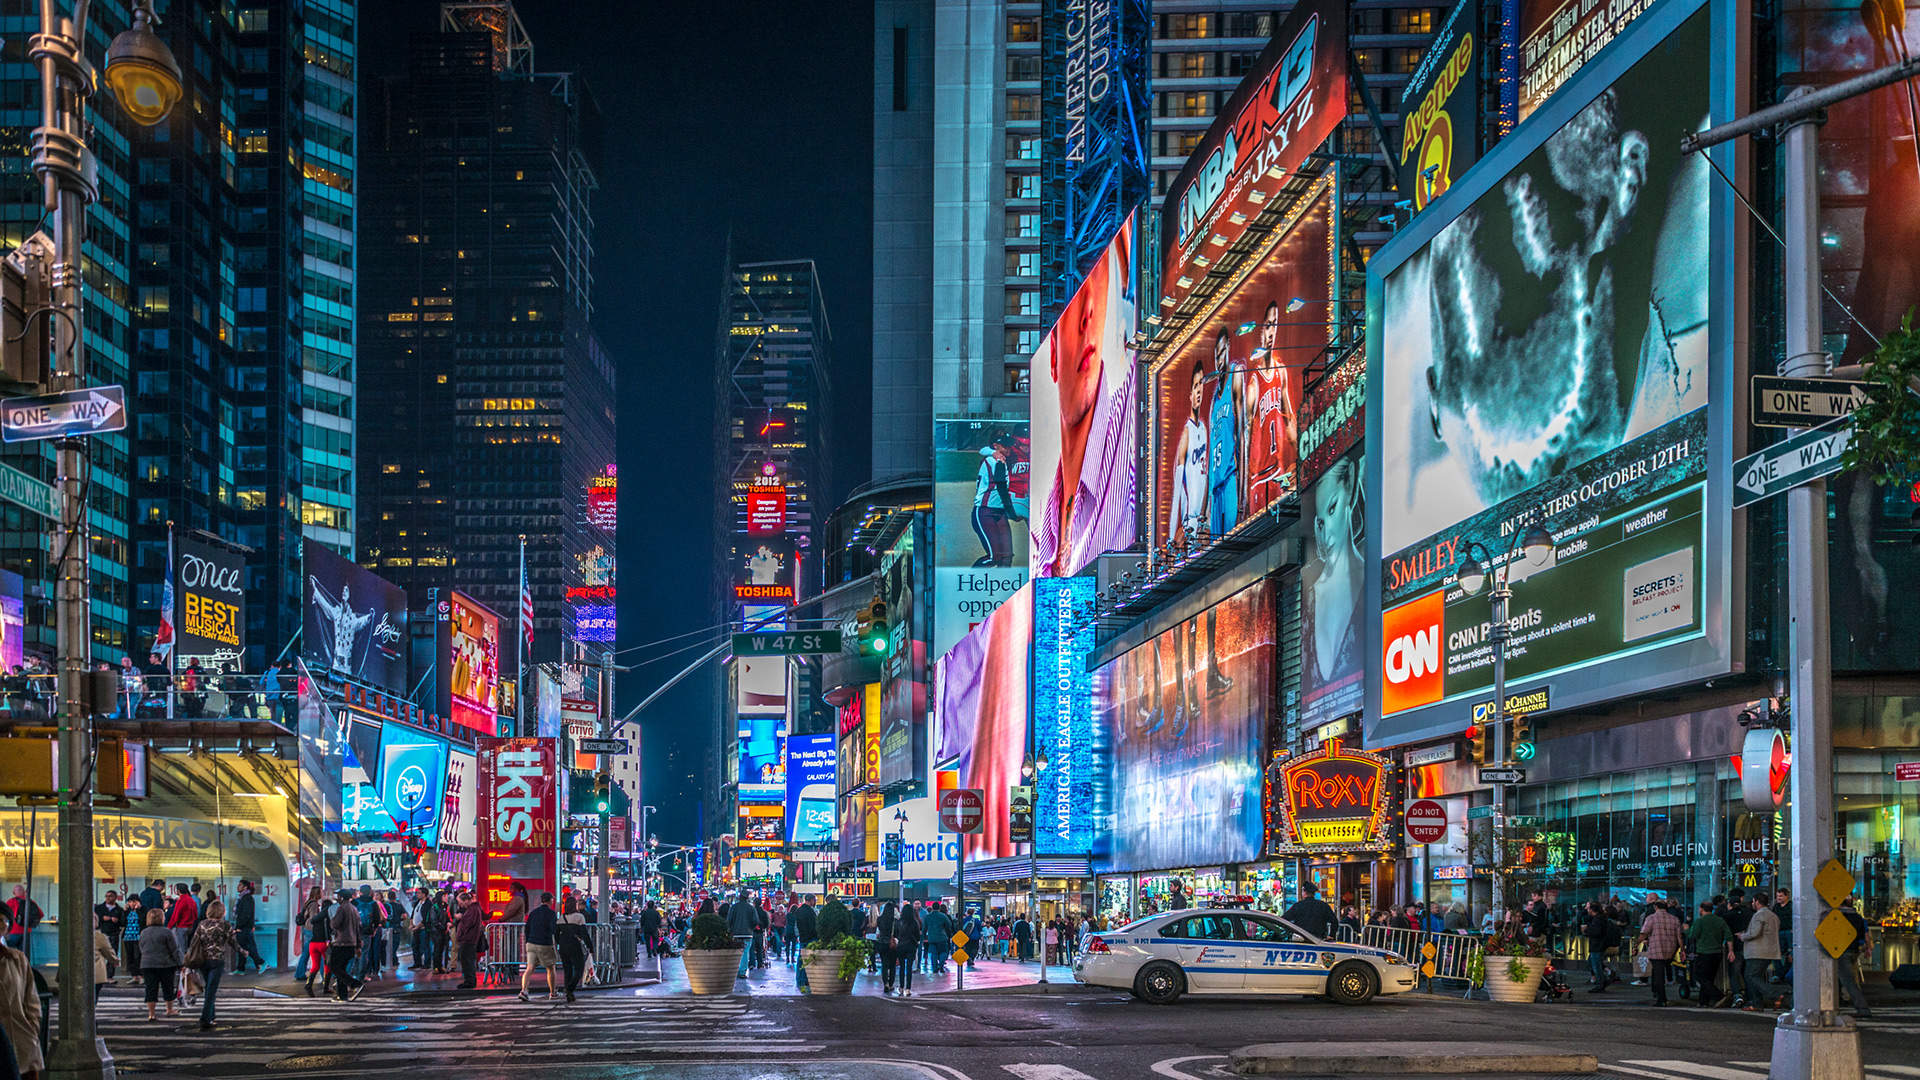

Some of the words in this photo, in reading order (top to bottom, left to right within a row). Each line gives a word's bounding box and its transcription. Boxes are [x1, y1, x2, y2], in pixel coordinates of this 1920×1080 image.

[1402, 33, 1472, 163] Avenue
[1179, 222, 1209, 268] EXECUTIVE
[1209, 178, 1243, 229] PRODUCED
[1243, 165, 1253, 185] BY
[1252, 113, 1294, 183] JAY
[1297, 89, 1314, 132] Z
[13, 406, 51, 426] ONE
[72, 401, 109, 420] WAY
[1773, 392, 1811, 412] ONE
[1829, 396, 1867, 414] WAY
[1299, 374, 1366, 460] CHICAGO
[1012, 461, 1030, 475] WEST
[1747, 460, 1778, 488] ONE
[1800, 437, 1836, 467] WAY
[748, 485, 785, 493] TOSHIBA
[755, 477, 780, 486] 2012
[1500, 519, 1514, 538] IN
[1580, 467, 1648, 503] OCTOBER
[1651, 439, 1689, 472] 12TH
[1625, 508, 1668, 534] weather
[1564, 527, 1578, 539] may
[1557, 539, 1588, 560] mobile
[1390, 536, 1459, 590] SMILEY
[735, 586, 793, 597] TOSHIBA
[957, 574, 1022, 596] Helped
[1632, 575, 1676, 597] SECRETS
[1632, 593, 1656, 606] BELFAST
[1657, 585, 1684, 598] PROJECT
[1445, 589, 1464, 603] .com
[185, 592, 239, 625] BEST
[185, 614, 239, 639] MUSICAL
[185, 625, 200, 636] 2012
[201, 630, 217, 640] TONY
[217, 633, 239, 646] AWARD
[1448, 626, 1478, 651] CNN
[1481, 608, 1542, 641] Pents
[752, 637, 766, 650] W
[772, 636, 796, 649] 47
[803, 635, 821, 649] St
[1058, 588, 1072, 691] OUTFITTERS
[1448, 653, 1461, 665] CNN
[1461, 645, 1493, 662] investigates
[1527, 629, 1545, 641] about
[1551, 622, 1572, 634] violent
[1573, 616, 1587, 628] time
[1588, 612, 1595, 623] in
[1386, 625, 1439, 684] CNN
[1448, 662, 1471, 675] Northern
[561, 718, 593, 727] EXPERIENCE
[840, 691, 861, 737] Kodak
[1057, 694, 1071, 749] EAGLE
[496, 747, 543, 842] tkts
[947, 798, 958, 806] DO
[961, 798, 976, 806] NOT
[1057, 752, 1071, 841] AMERICAN
[806, 809, 831, 823] 12:45
[949, 817, 974, 825] ENTER
[1412, 808, 1423, 816] DO
[1425, 808, 1440, 816] NOT
[1468, 806, 1490, 819] BROADWAY
[1526, 817, 1537, 826] 47
[1303, 825, 1363, 838] DELICATESSEN
[1414, 828, 1439, 836] ENTER
[1580, 848, 1608, 862] BLUE
[1612, 847, 1630, 859] FIN
[1651, 843, 1683, 858] BLUE
[1687, 842, 1708, 855] FIN
[1733, 838, 1770, 853] BLUE
[1776, 837, 1793, 850] FI
[437, 849, 474, 873] FOREVER
[1616, 862, 1643, 870] OYSTERS
[1658, 861, 1675, 869] SUSHI
[1735, 857, 1765, 865] BRUNCH
[1438, 867, 1455, 878] BLUE
[265, 884, 278, 896] 12
[1263, 950, 1318, 967] NYPD
